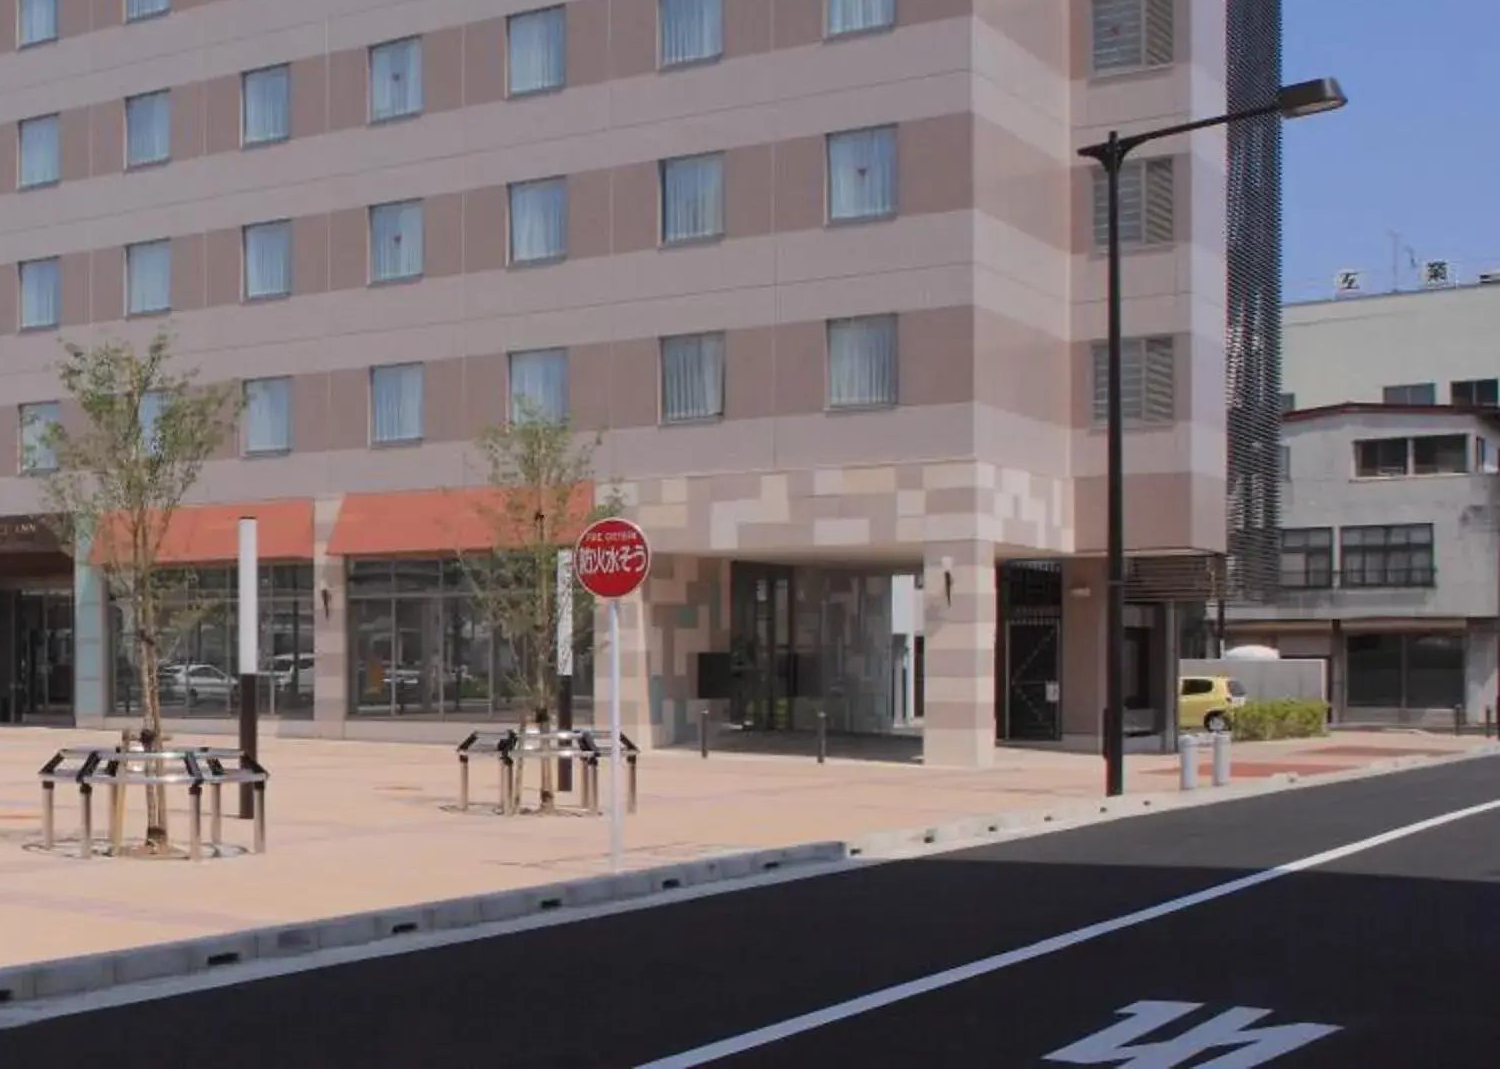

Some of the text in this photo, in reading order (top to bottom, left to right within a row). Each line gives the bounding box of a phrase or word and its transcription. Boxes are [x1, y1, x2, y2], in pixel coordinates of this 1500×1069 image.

[579, 544, 647, 575] 防火水そう
